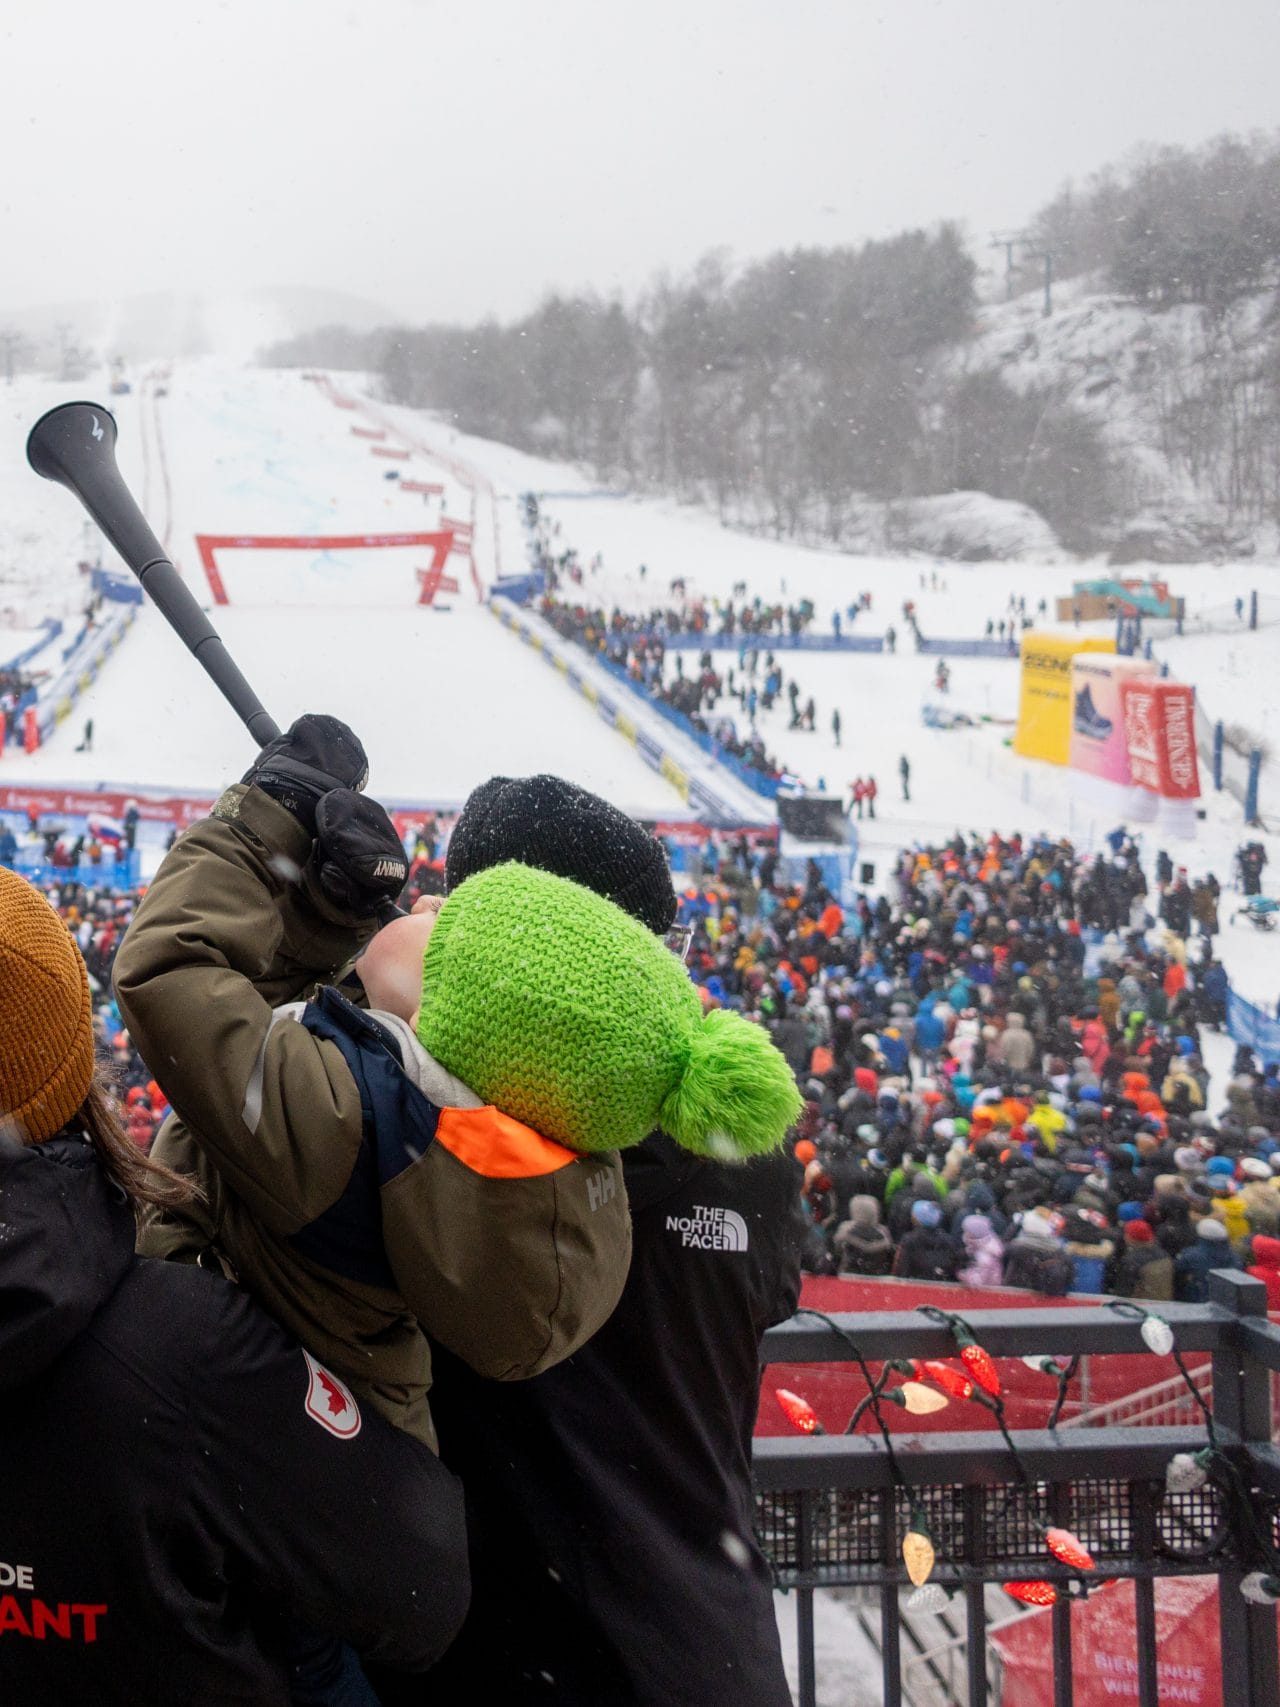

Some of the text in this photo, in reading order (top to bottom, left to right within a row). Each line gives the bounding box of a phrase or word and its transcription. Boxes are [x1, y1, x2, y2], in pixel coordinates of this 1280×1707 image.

[586, 1166, 617, 1212] HH
[692, 1205, 724, 1222] THE
[666, 1216, 723, 1236] NORTH
[682, 1233, 724, 1250] FACE
[1094, 1651, 1206, 1682] BIENENUE
[1102, 1678, 1201, 1704] WELOME
